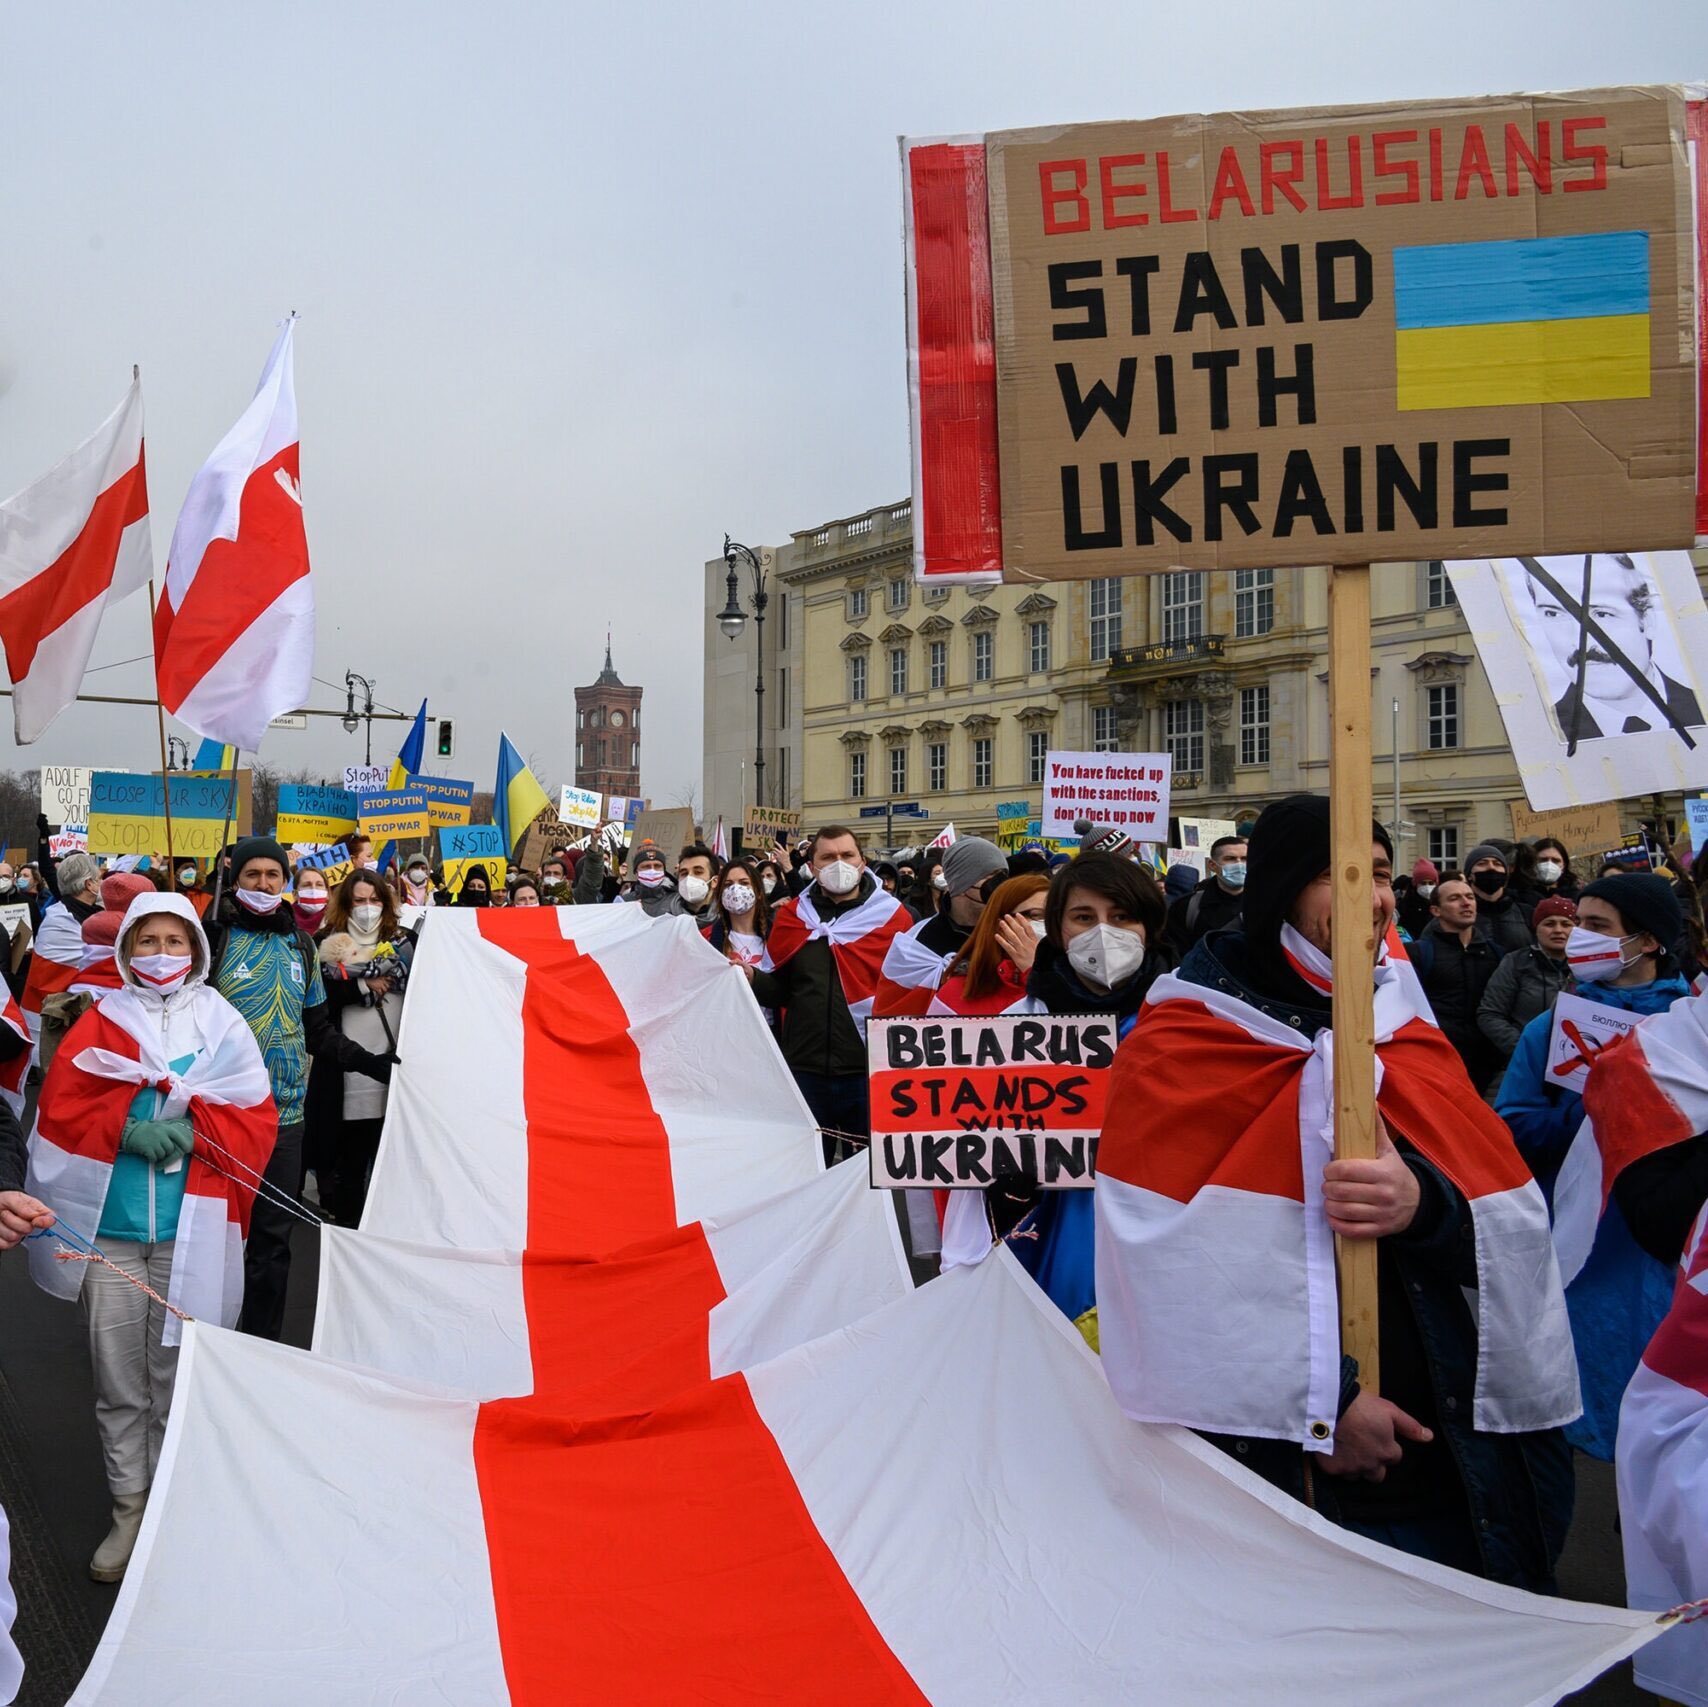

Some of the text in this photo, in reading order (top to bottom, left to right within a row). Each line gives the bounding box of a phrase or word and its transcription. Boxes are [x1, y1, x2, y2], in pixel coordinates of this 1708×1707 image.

[1038, 116, 1607, 235] BELARUSIANS
[1047, 238, 1374, 341] STAND
[1055, 343, 1318, 442] WITH
[1061, 438, 1512, 552] UKRAINE
[45, 767, 81, 787] ADOLF
[1051, 763, 1164, 783] You have fucked up
[58, 787, 73, 804] GO
[363, 795, 423, 809] STOP PUTIN
[438, 786, 469, 798] PUTIN
[1051, 785, 1161, 803] with the sanctions,
[438, 810, 461, 821] WAR
[751, 808, 800, 825] PROTECT
[1085, 808, 1111, 822] fuck
[1113, 811, 1127, 825] up
[1129, 811, 1156, 824] now
[368, 820, 421, 833] STOP WAR
[451, 831, 500, 853] #STOP
[886, 1020, 1115, 1069] BELARUS
[890, 1074, 1090, 1118] STANDS
[956, 1113, 1046, 1132] WITH
[883, 1132, 1100, 1184] UKRAIN
